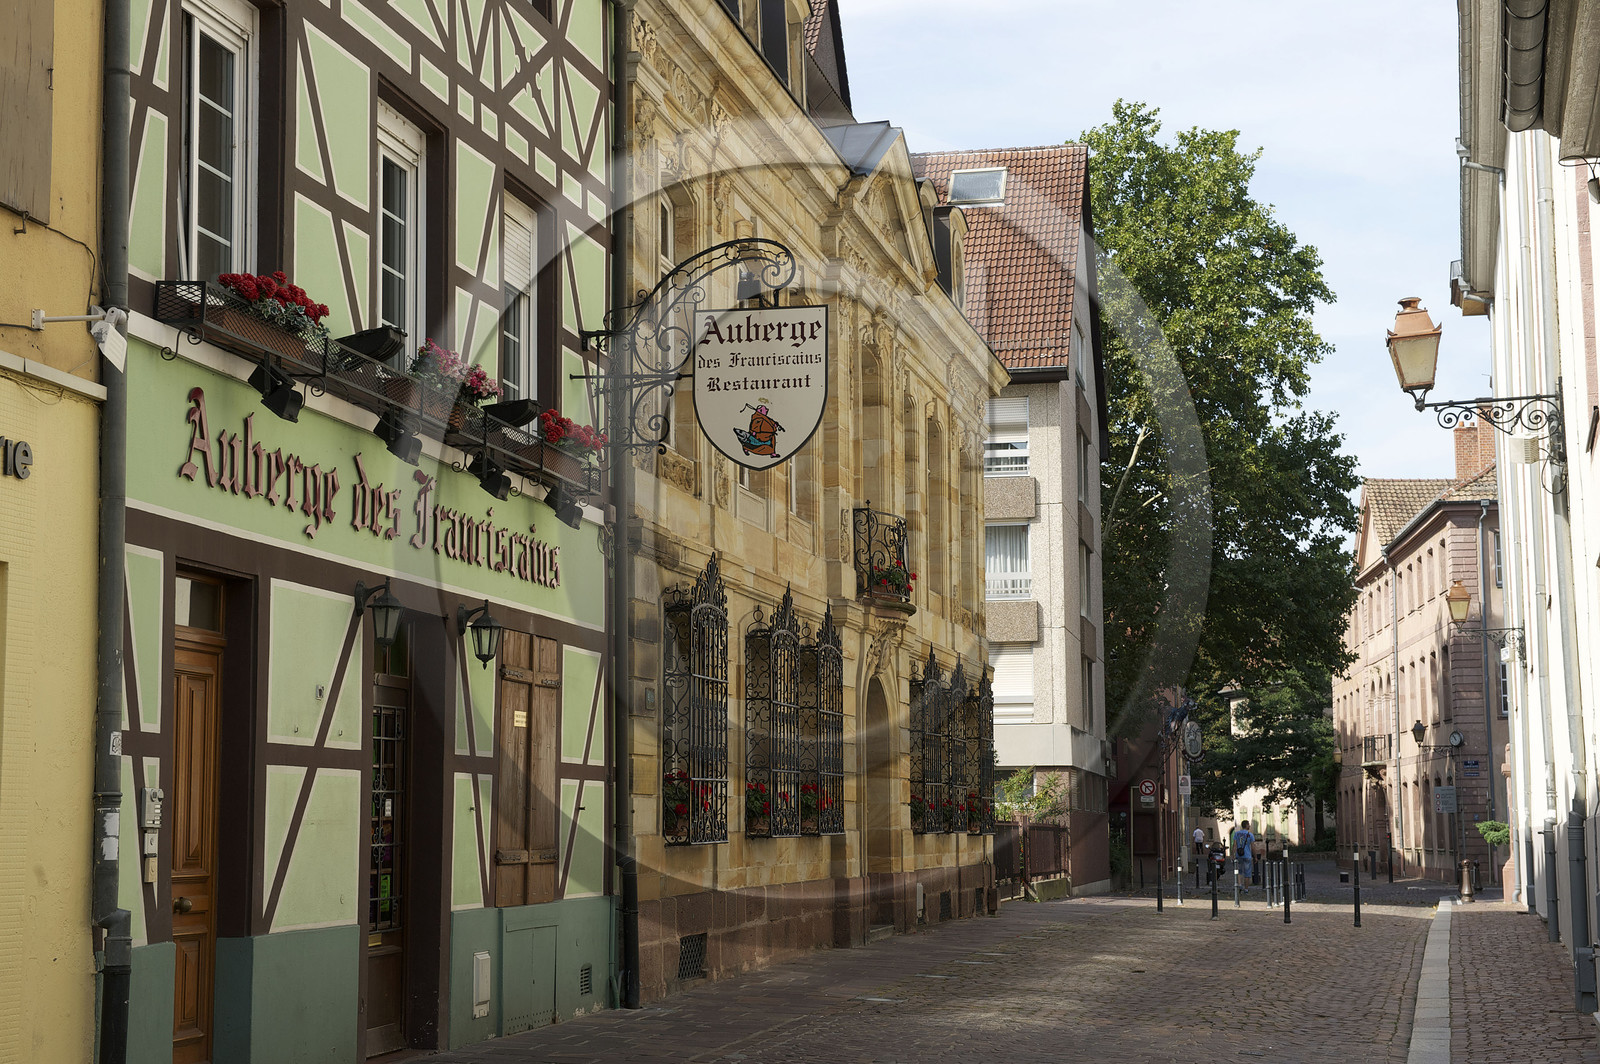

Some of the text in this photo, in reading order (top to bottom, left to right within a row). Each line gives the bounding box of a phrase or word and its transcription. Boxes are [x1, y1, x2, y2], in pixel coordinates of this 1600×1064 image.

[699, 314, 822, 347] Auberge
[697, 351, 822, 369] des Franciscains
[706, 374, 811, 392] Restaurant
[178, 386, 561, 589] Auberge des Franciscains
